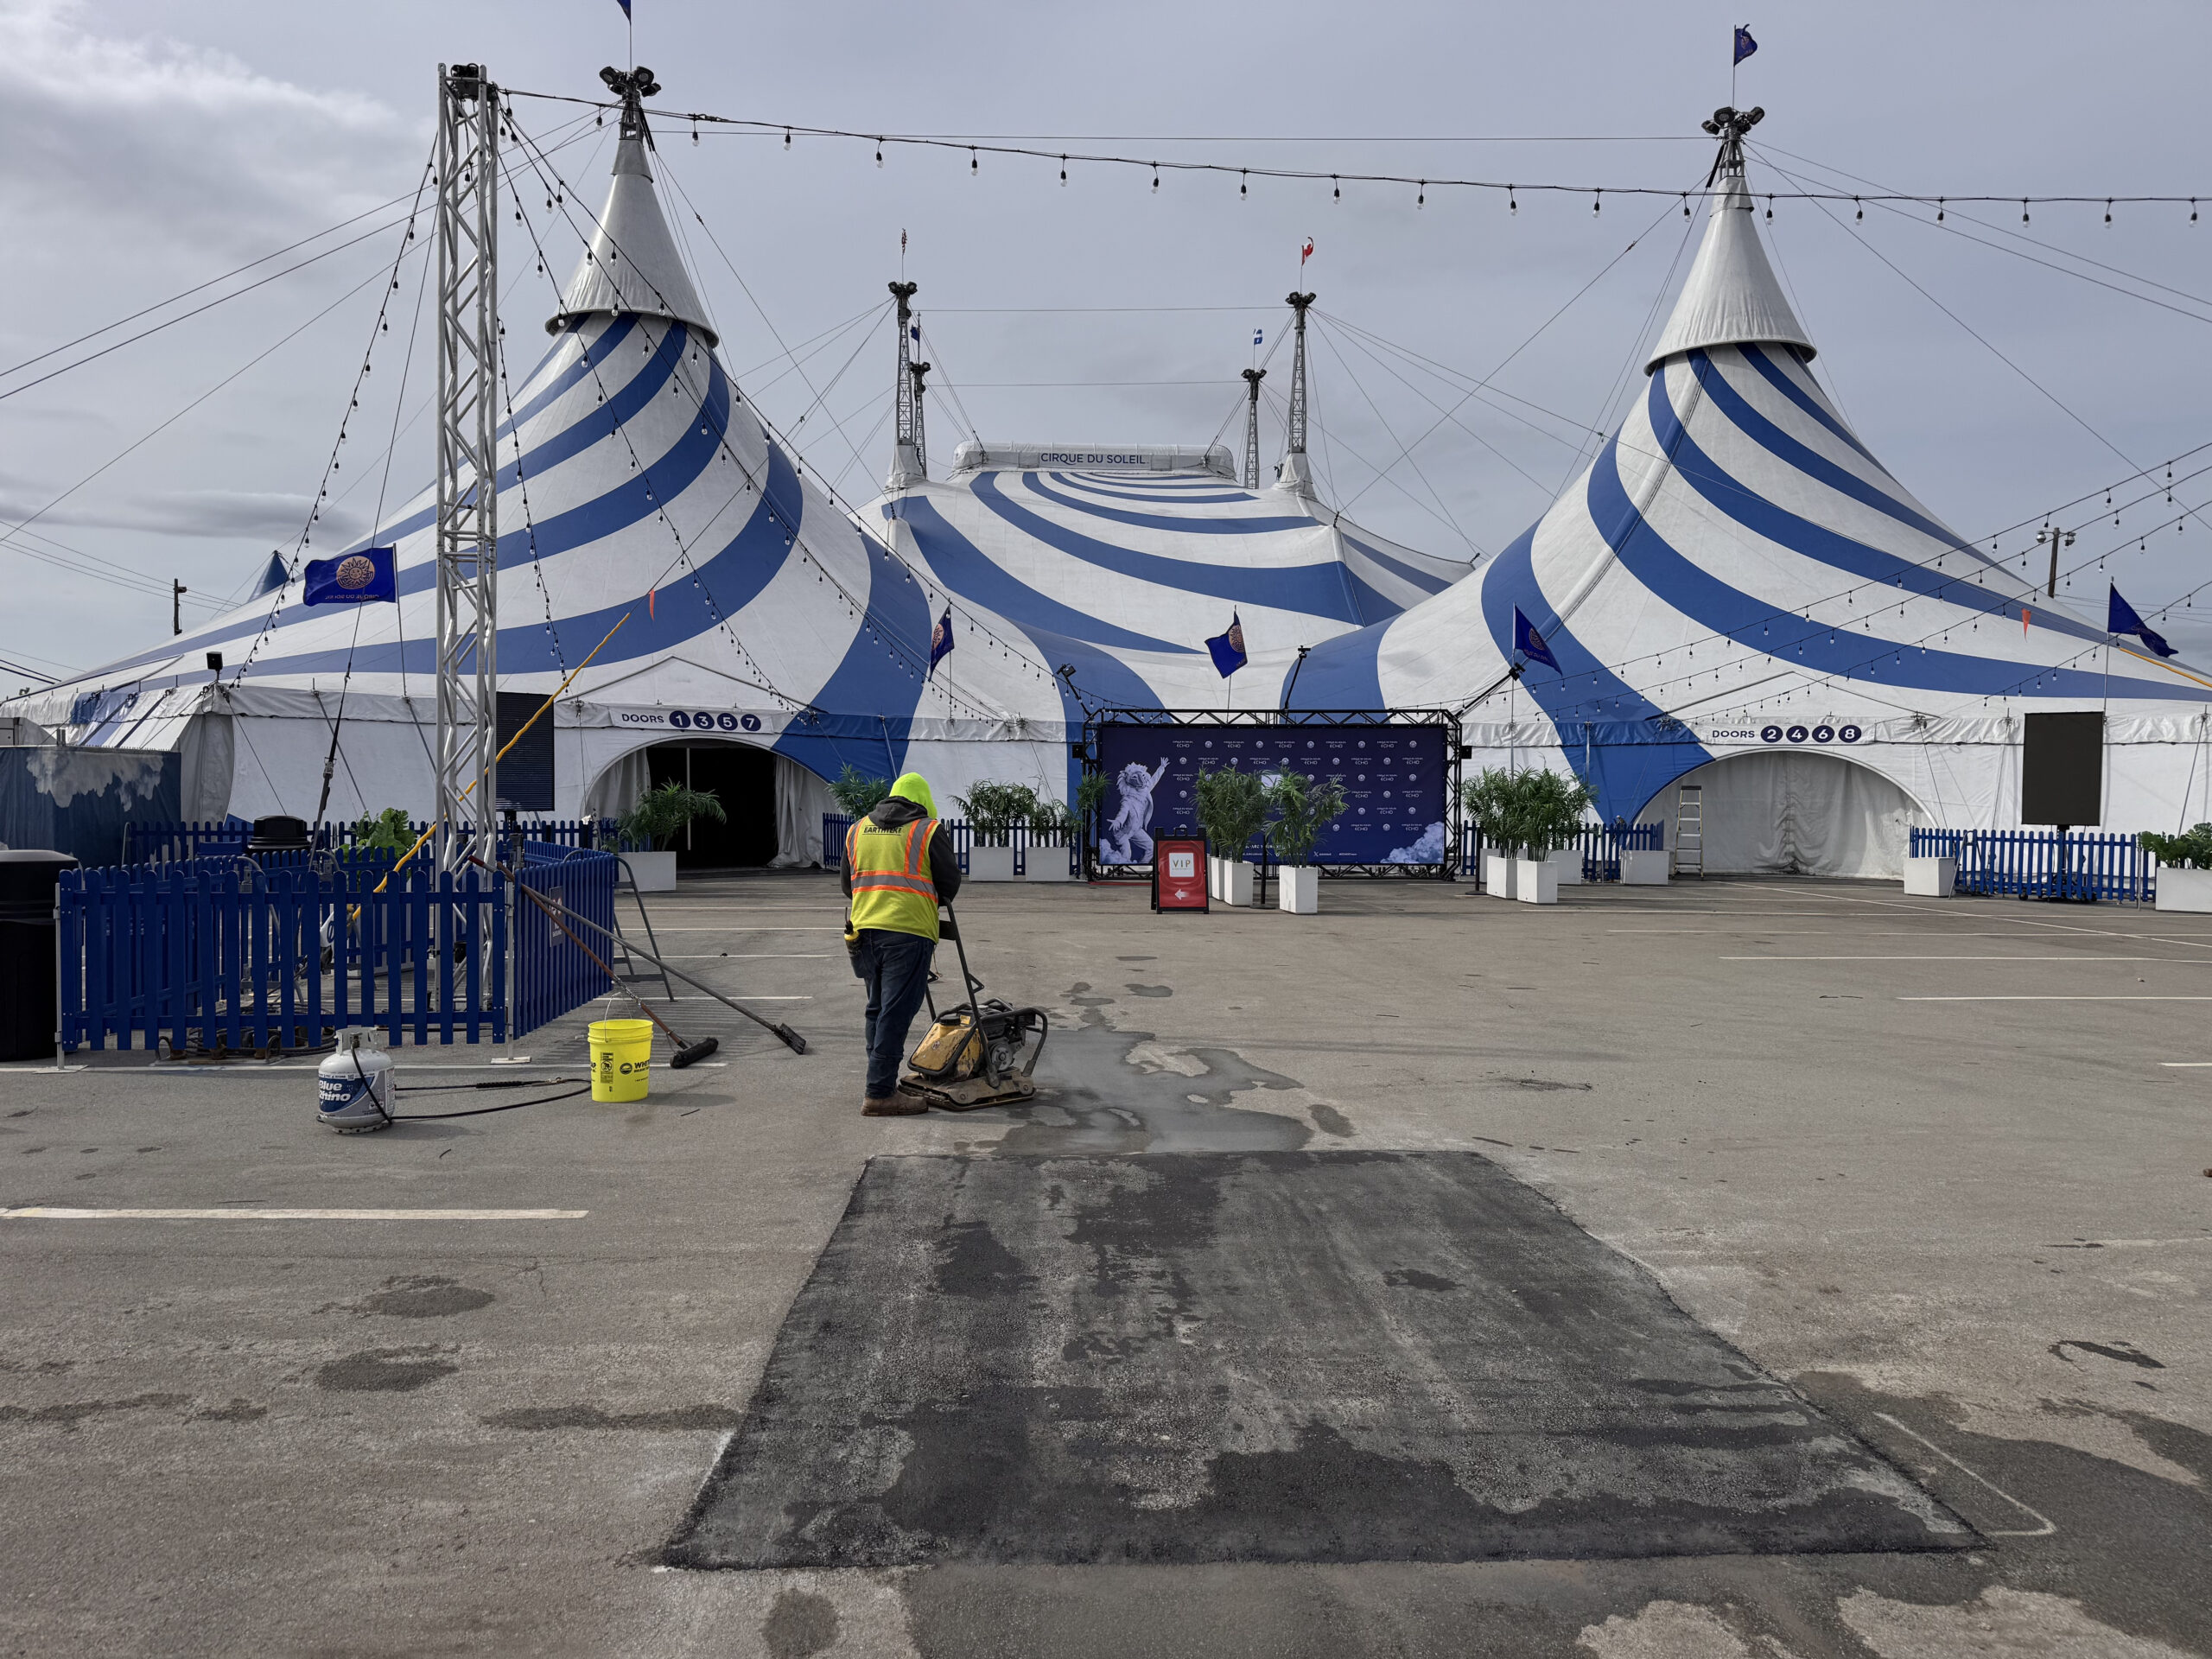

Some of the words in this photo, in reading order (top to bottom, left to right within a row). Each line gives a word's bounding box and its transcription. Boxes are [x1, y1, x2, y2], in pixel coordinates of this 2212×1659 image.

[1040, 453, 1084, 465] CIRQUE
[1087, 454, 1103, 463] DU
[1107, 454, 1146, 464] SOLEIL
[622, 714, 664, 722] DOORS
[1173, 859, 1191, 868] VIP
[319, 1080, 342, 1090] Blue
